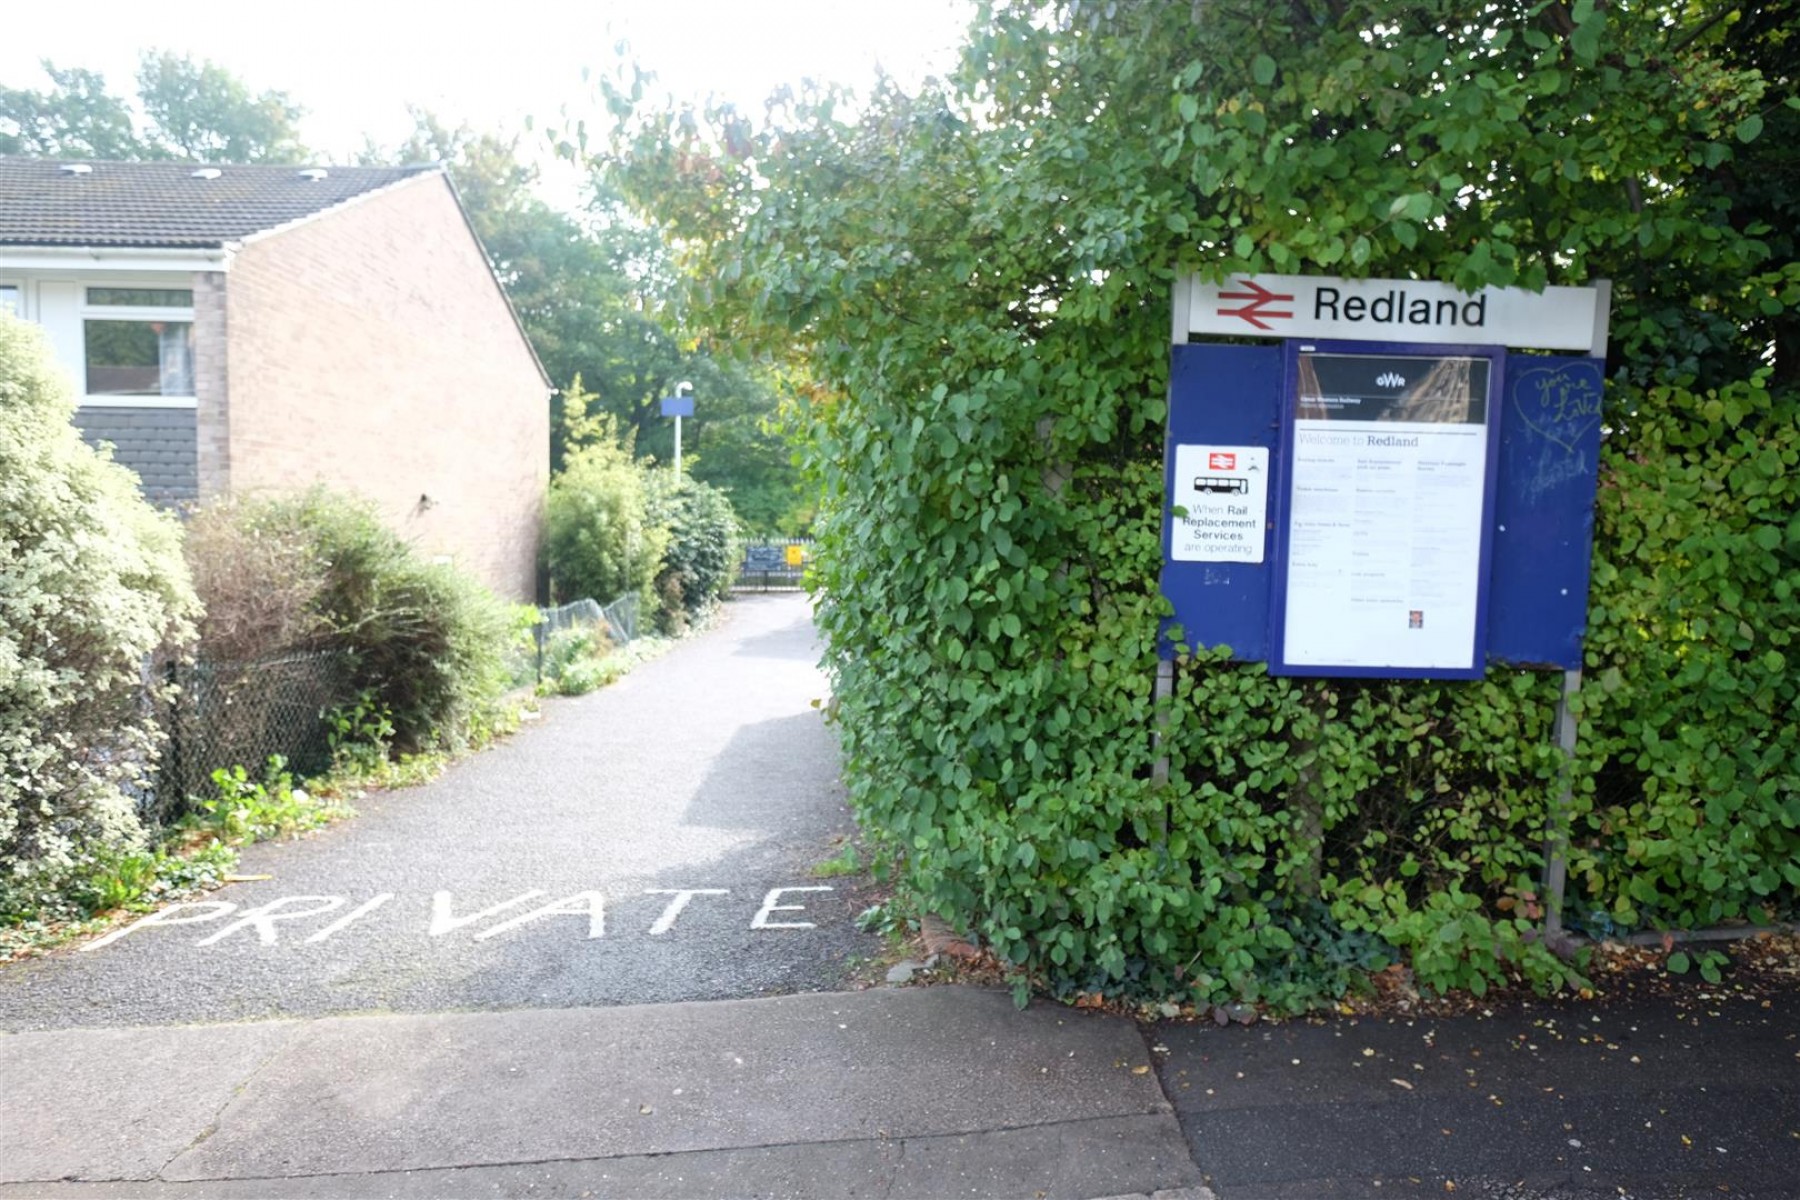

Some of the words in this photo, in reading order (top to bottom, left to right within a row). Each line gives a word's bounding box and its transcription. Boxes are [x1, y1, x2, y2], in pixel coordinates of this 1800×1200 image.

[1314, 286, 1487, 327] Redland
[1376, 372, 1406, 388] GWR
[1299, 434, 1350, 446] Welcome
[1354, 435, 1365, 446] to
[1367, 435, 1419, 448] Redland
[1193, 504, 1224, 514] When
[1228, 505, 1248, 515] Rail
[1183, 517, 1256, 530] Replacement
[1194, 530, 1244, 541] Services
[1184, 544, 1201, 552] are
[1204, 543, 1253, 555] operating
[80, 885, 835, 953] PRIVATE
